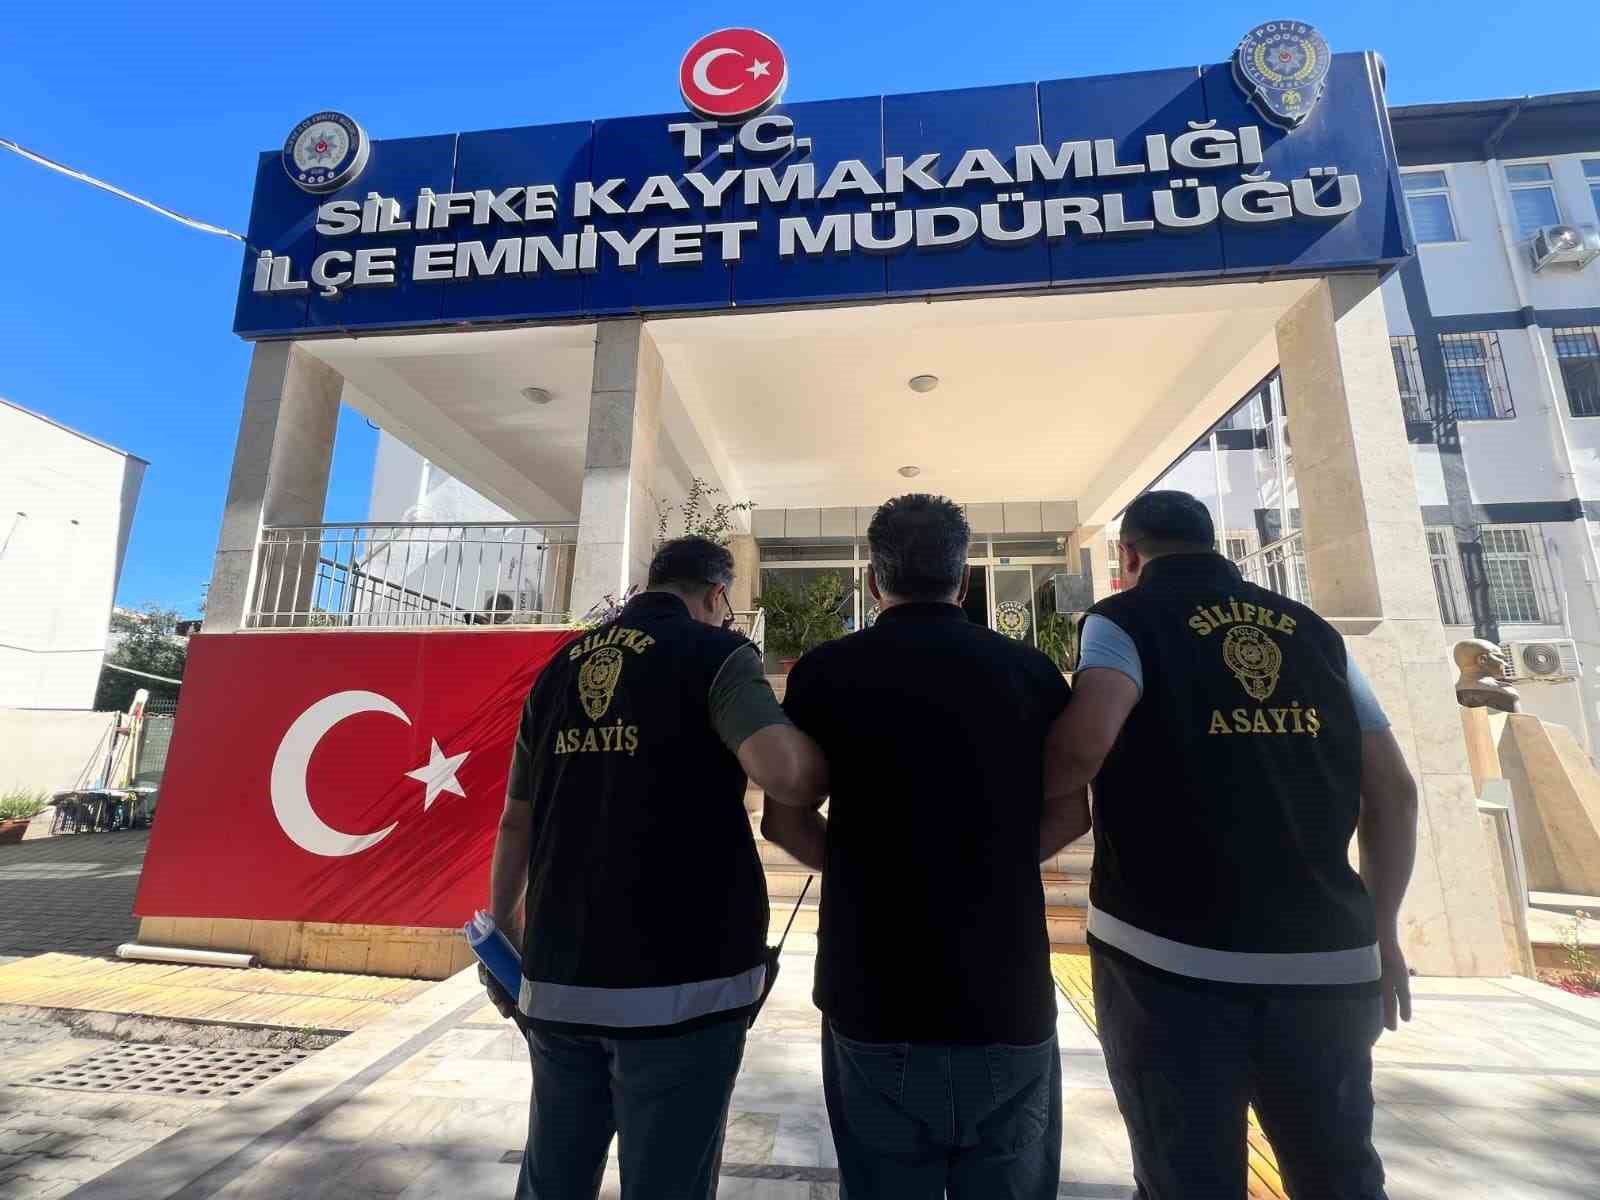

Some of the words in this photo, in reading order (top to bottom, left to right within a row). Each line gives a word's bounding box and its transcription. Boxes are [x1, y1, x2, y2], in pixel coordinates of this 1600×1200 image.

[668, 115, 811, 158] T.C.
[316, 184, 558, 236] SİLİFKE
[574, 119, 1264, 217] KAYMAKAMLIĞI
[252, 248, 397, 296] İLÇE
[412, 221, 758, 281] EMNİYET
[780, 167, 1362, 256] MÜDÜRLÜĞÜ
[1188, 596, 1297, 635] SİLİFKE
[569, 625, 656, 661] SİLİFKE
[554, 718, 639, 757] ASAYİŞ
[1207, 700, 1321, 738] ASAYİŞ
